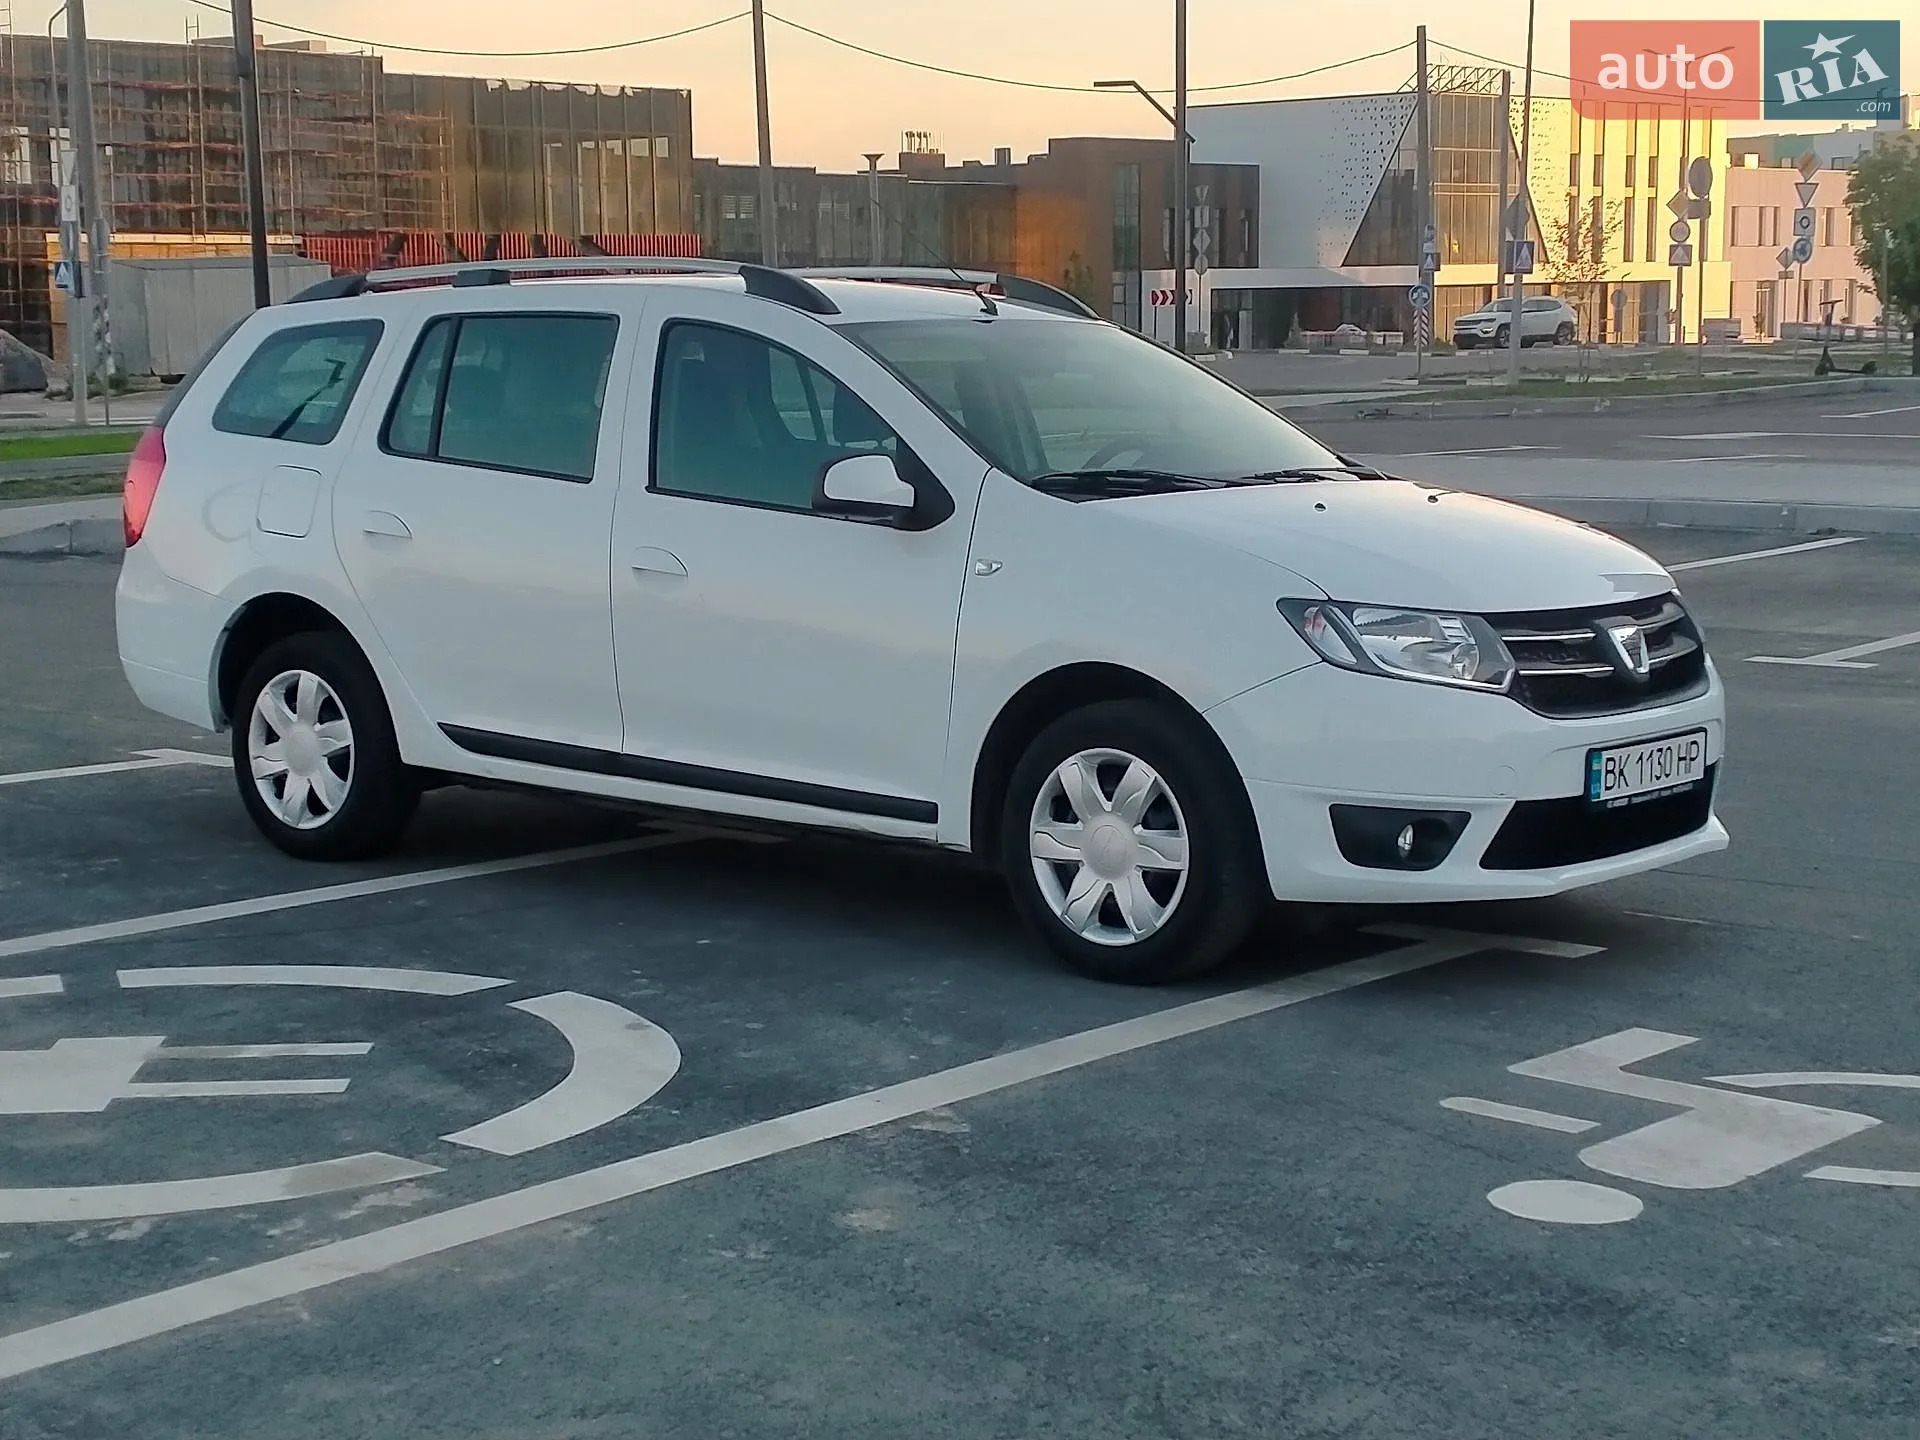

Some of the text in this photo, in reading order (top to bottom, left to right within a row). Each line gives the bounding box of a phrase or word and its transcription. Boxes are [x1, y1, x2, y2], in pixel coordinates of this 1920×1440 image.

[1605, 741, 1700, 791] BK 1130 HP
